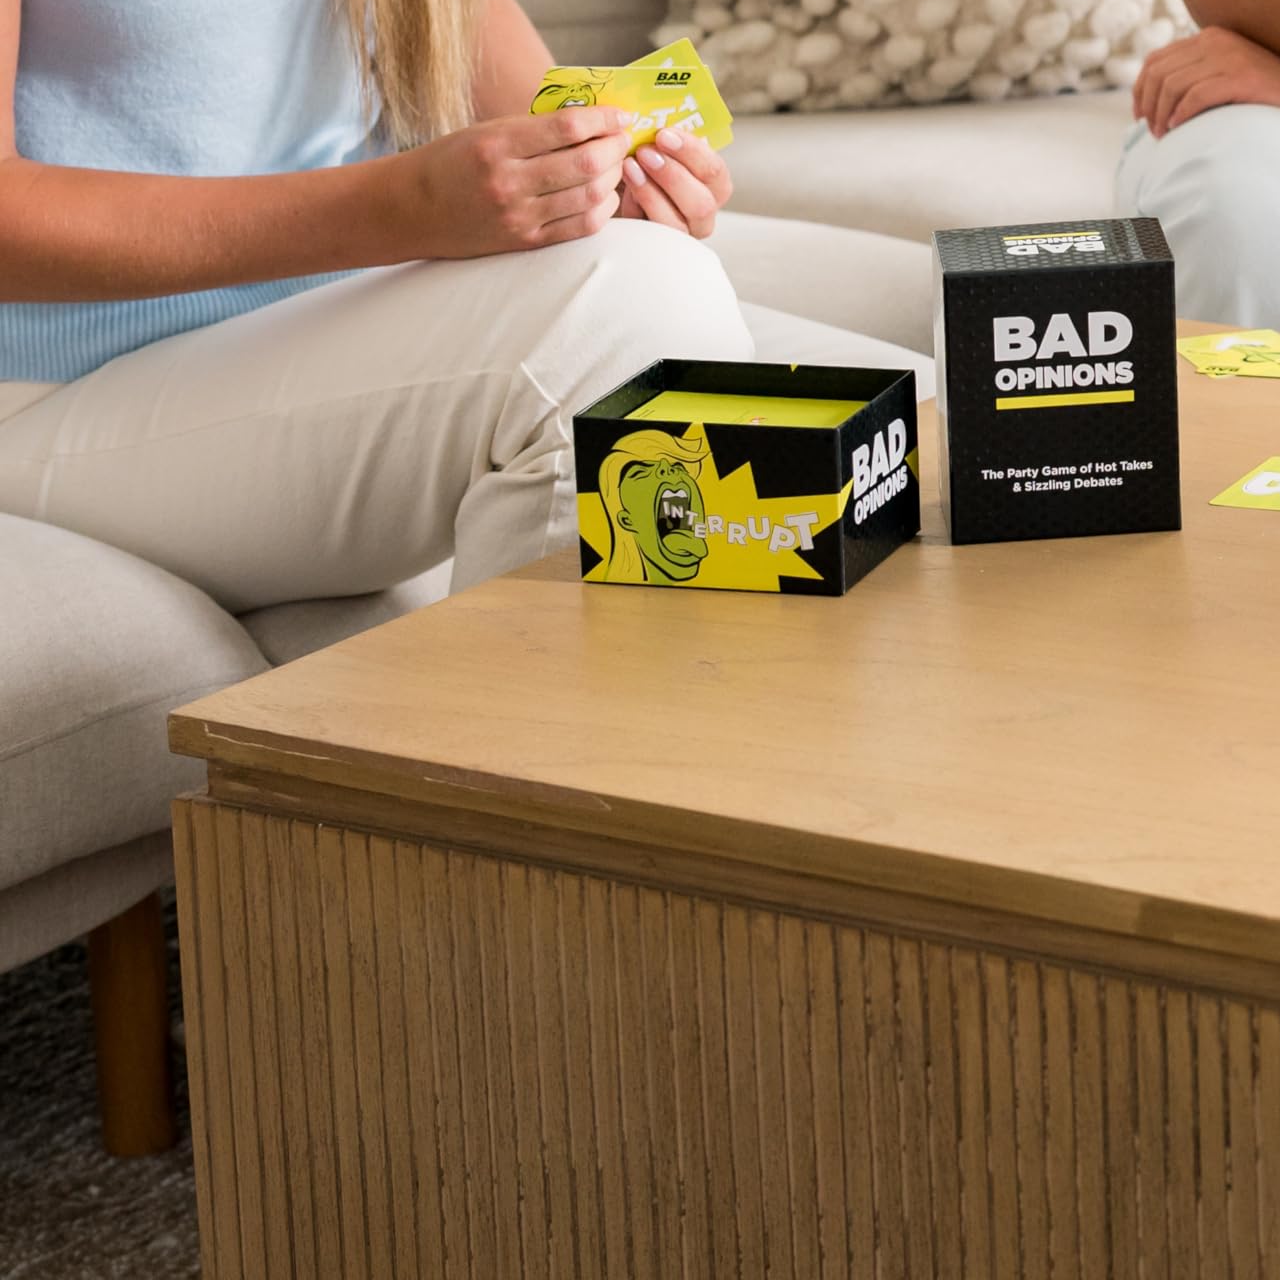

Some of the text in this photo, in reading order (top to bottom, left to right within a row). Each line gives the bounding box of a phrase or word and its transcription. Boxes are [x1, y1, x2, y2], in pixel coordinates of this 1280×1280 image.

[656, 72, 691, 81] BAD
[1004, 235, 1102, 246] OPINIONS
[1006, 240, 1106, 255] BAD
[993, 311, 1133, 362] BAD
[994, 361, 1134, 391] OPINIONS
[852, 417, 907, 500] BAD
[981, 460, 1153, 480] The Party Game of Hot Takes
[854, 464, 908, 526] OPINIONS
[1012, 476, 1123, 492] & Sizzling Debates
[662, 501, 819, 553] INTERRUPT
